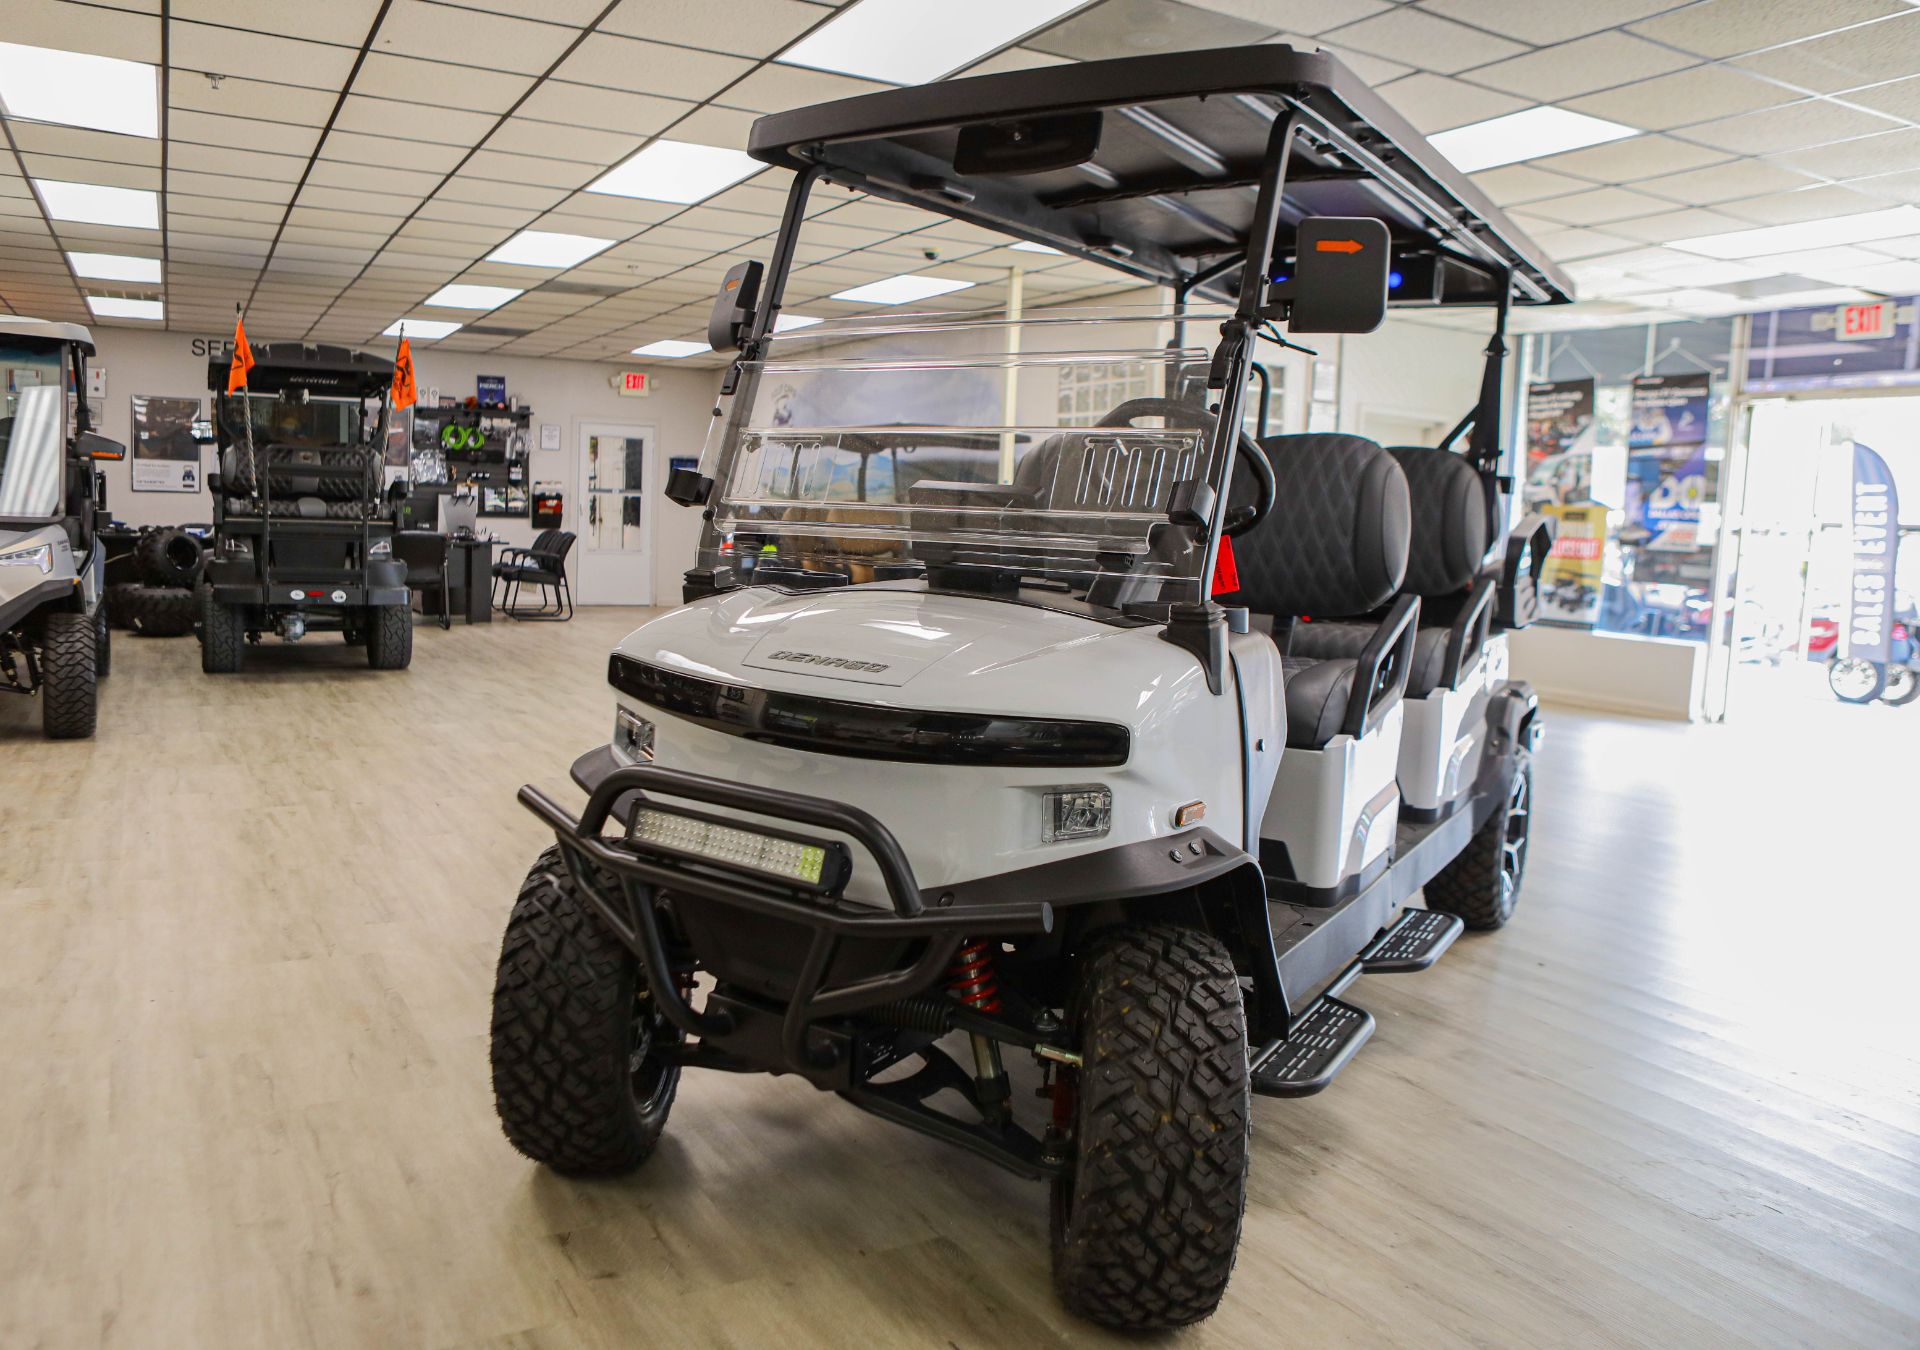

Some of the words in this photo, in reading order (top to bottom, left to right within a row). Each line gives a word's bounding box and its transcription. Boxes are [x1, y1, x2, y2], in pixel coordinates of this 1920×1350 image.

[1845, 303, 1882, 334] EXIT
[625, 373, 645, 390] EXIT
[1853, 481, 1889, 554] EVENT
[1851, 574, 1886, 646] SALES
[768, 650, 890, 673] DENAGO
